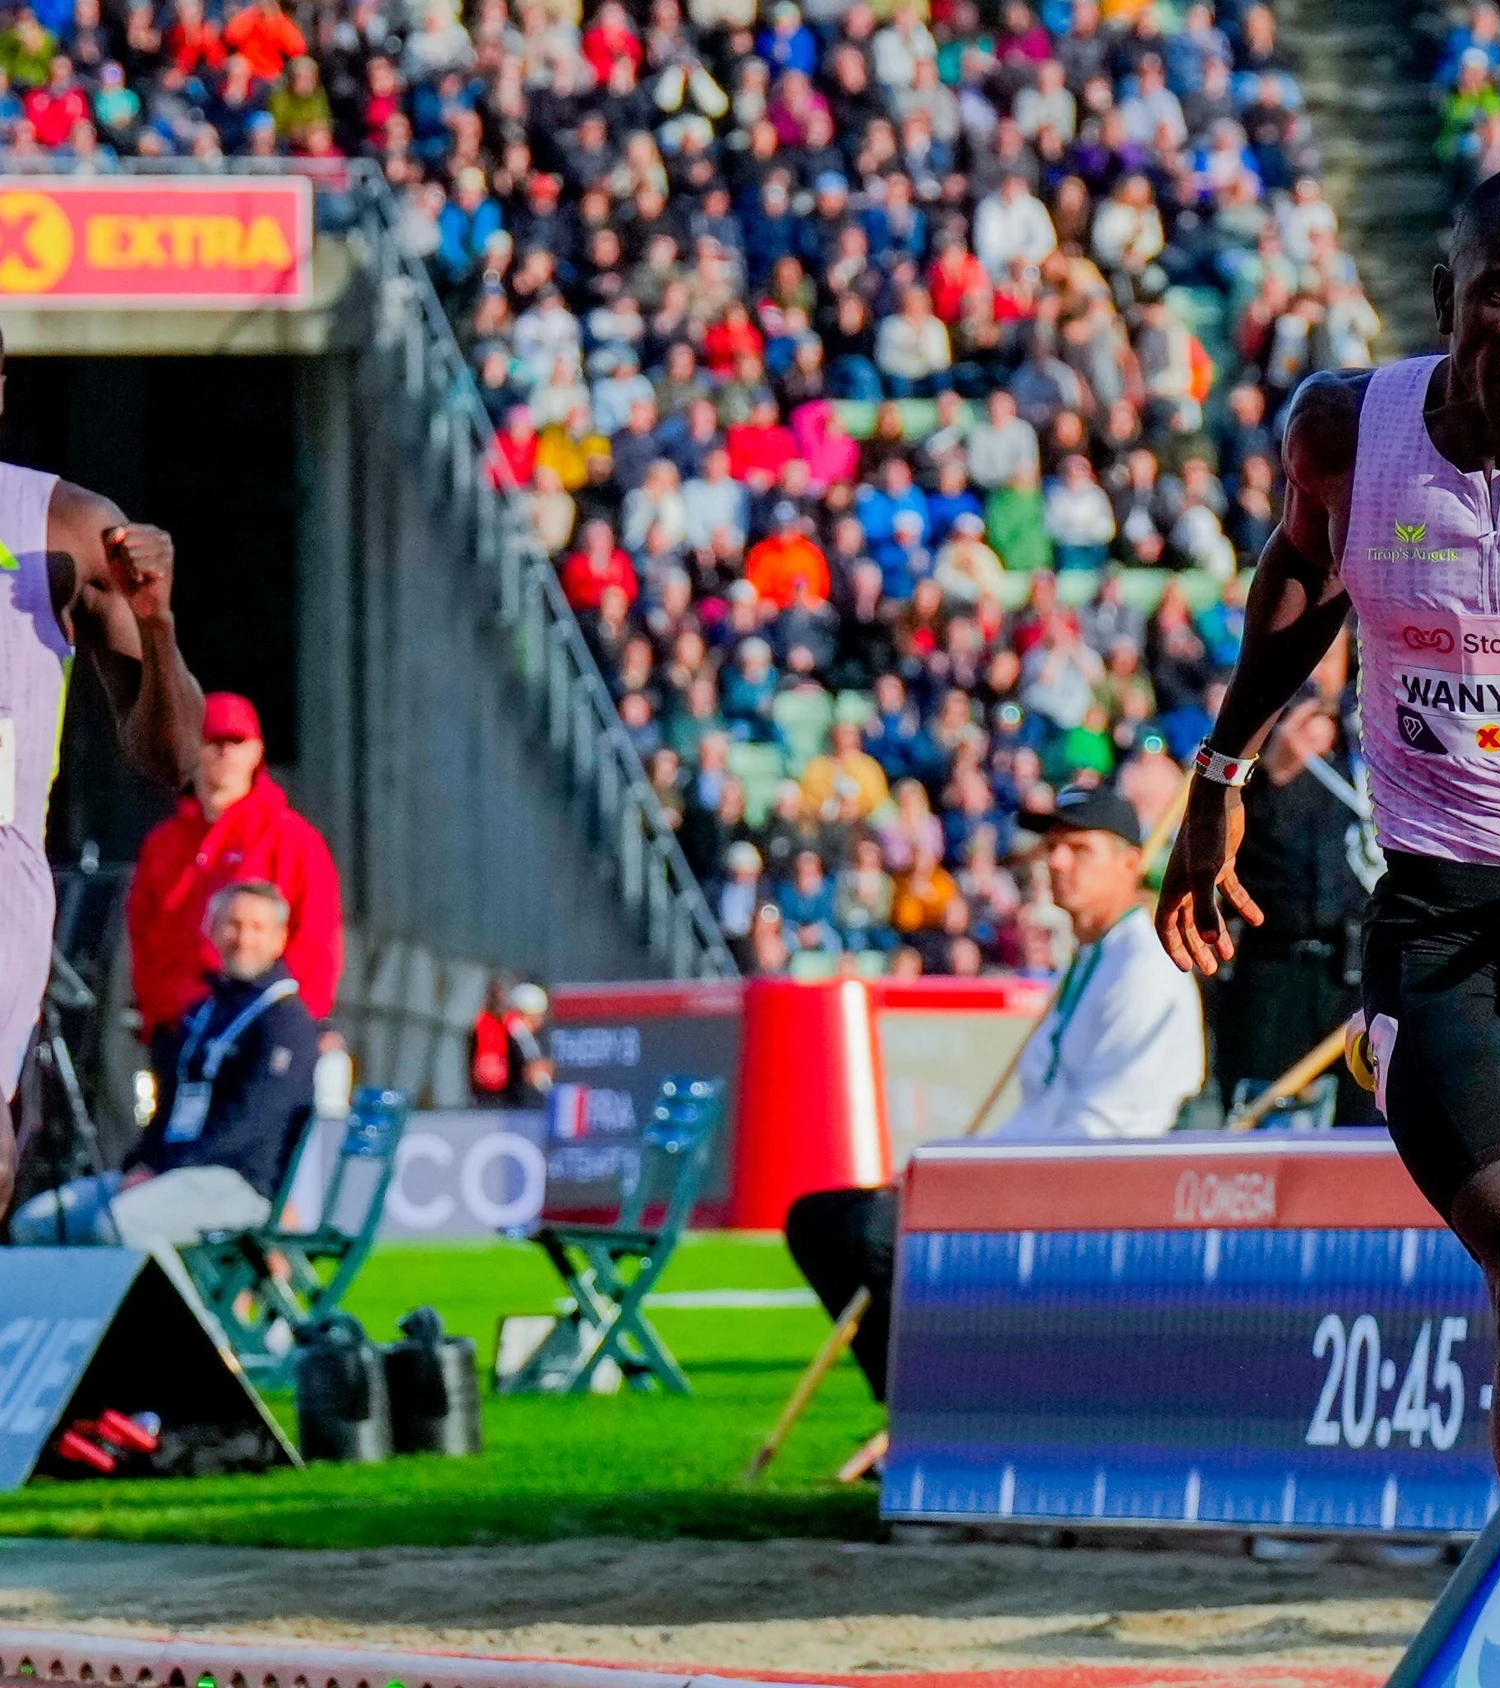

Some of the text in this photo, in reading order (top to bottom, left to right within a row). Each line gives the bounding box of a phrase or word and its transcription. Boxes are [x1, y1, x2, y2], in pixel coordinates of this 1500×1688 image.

[87, 214, 294, 271] EXTRA
[1366, 547, 1459, 564] Tirop's Angels
[1199, 1172, 1276, 1219] OMEGA
[1306, 1313, 1469, 1451] 20:45
